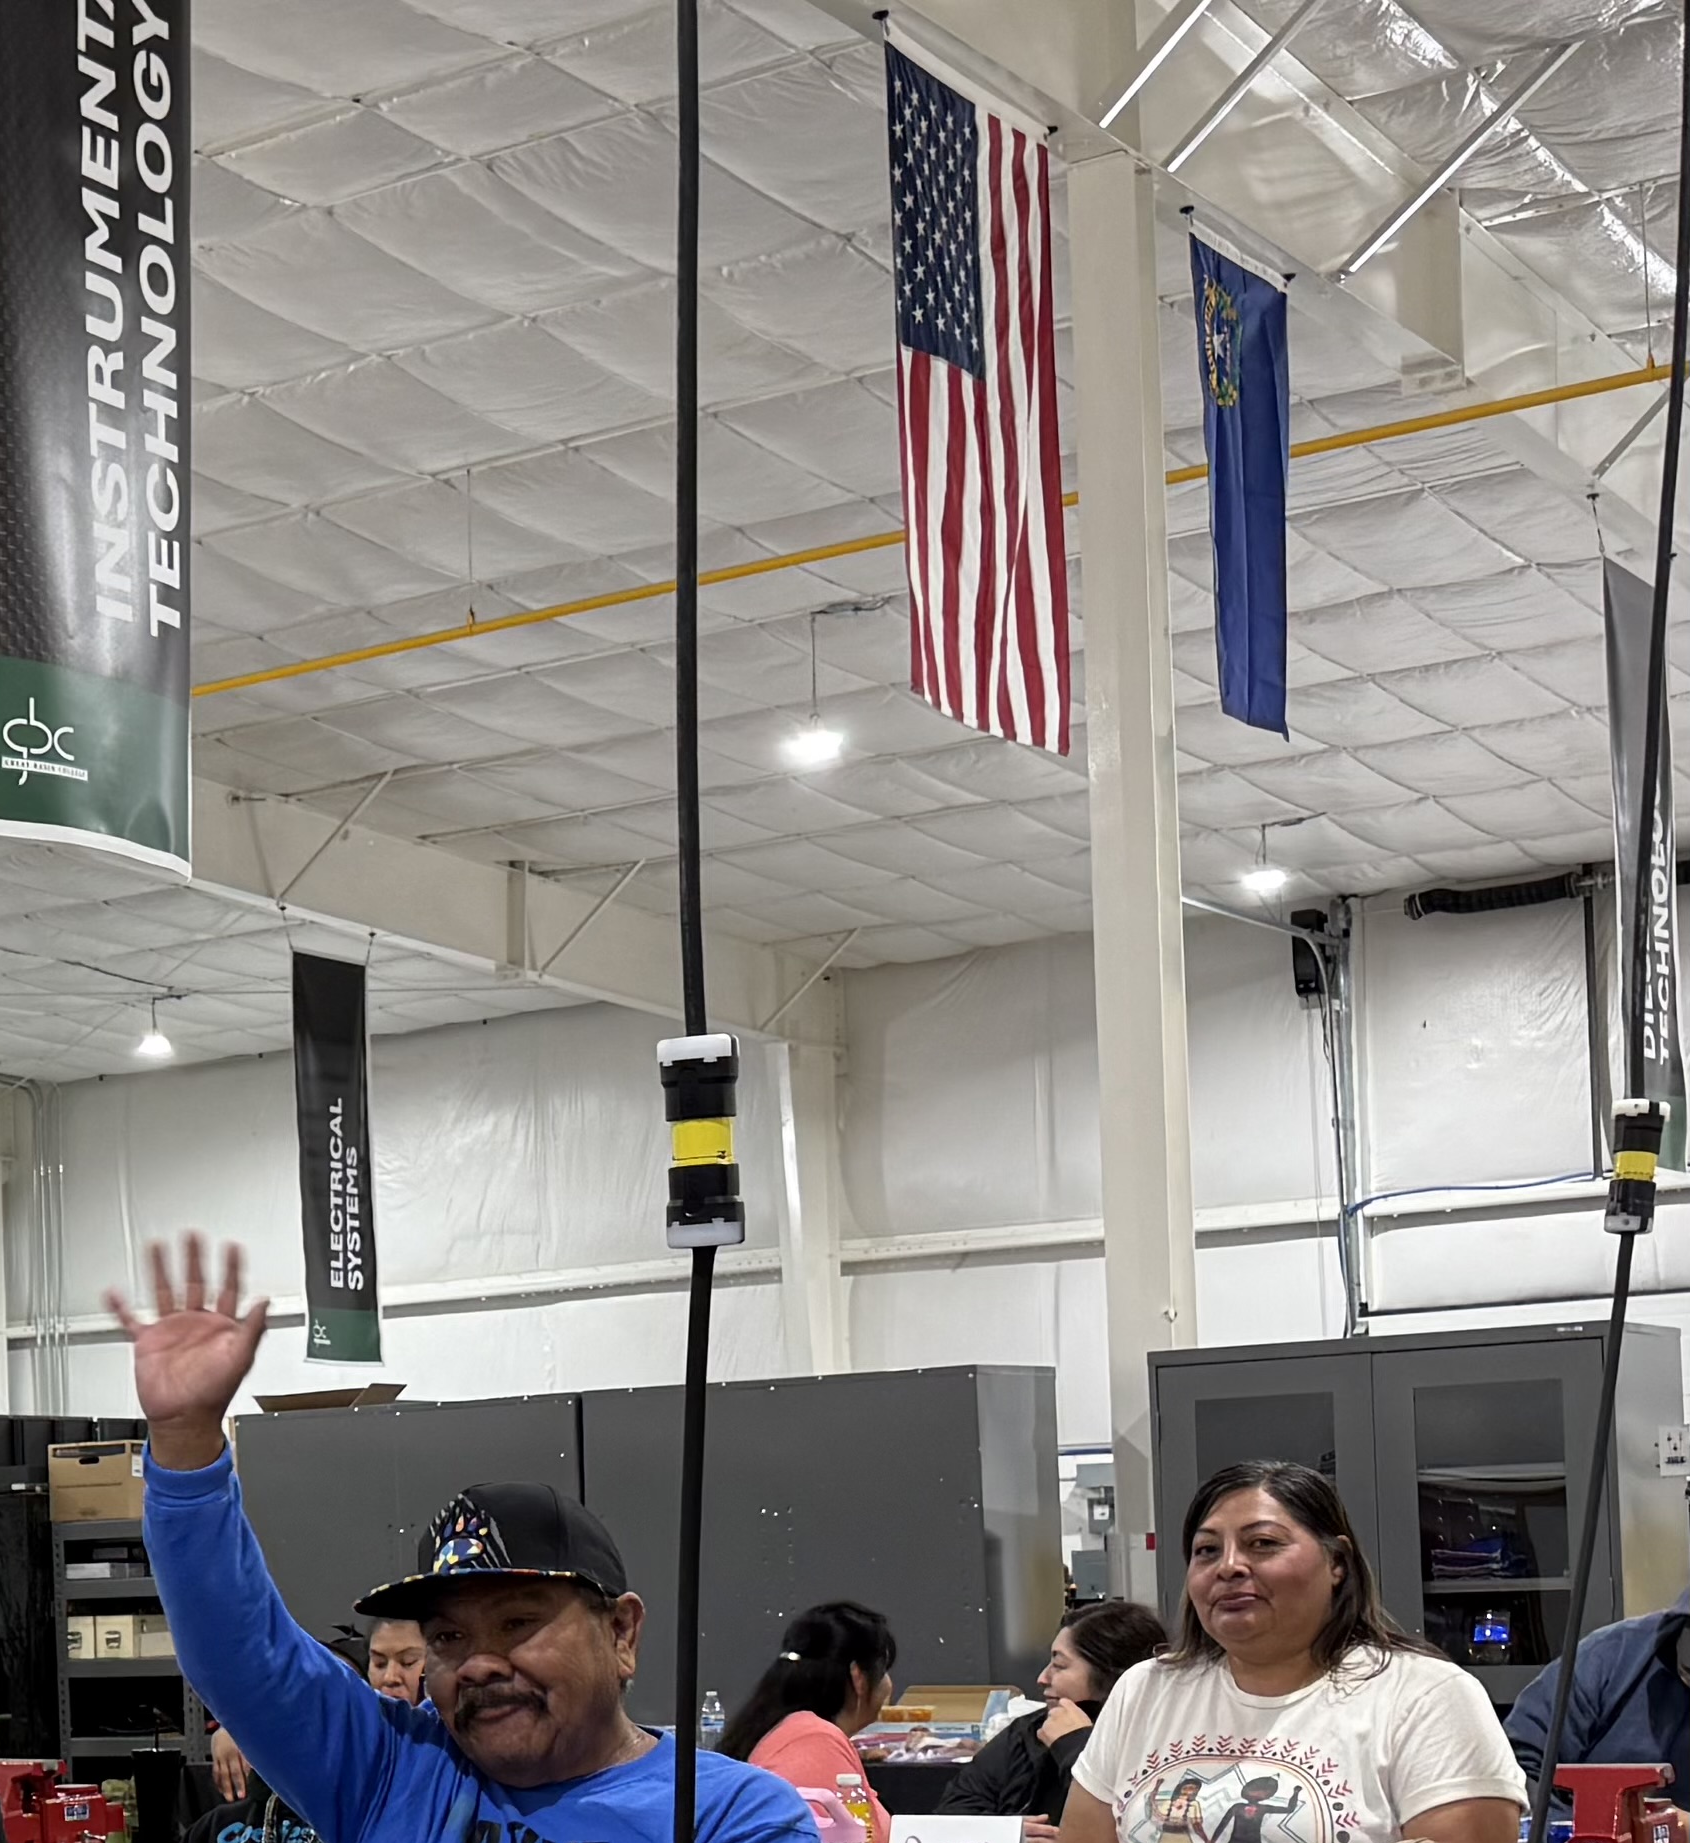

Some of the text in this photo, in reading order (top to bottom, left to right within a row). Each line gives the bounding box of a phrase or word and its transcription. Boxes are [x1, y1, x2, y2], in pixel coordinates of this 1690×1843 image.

[132, 0, 181, 637] TECHNOLOGY
[329, 1097, 344, 1288] ELECTRICAL
[346, 1146, 364, 1290] SYSTEMS
